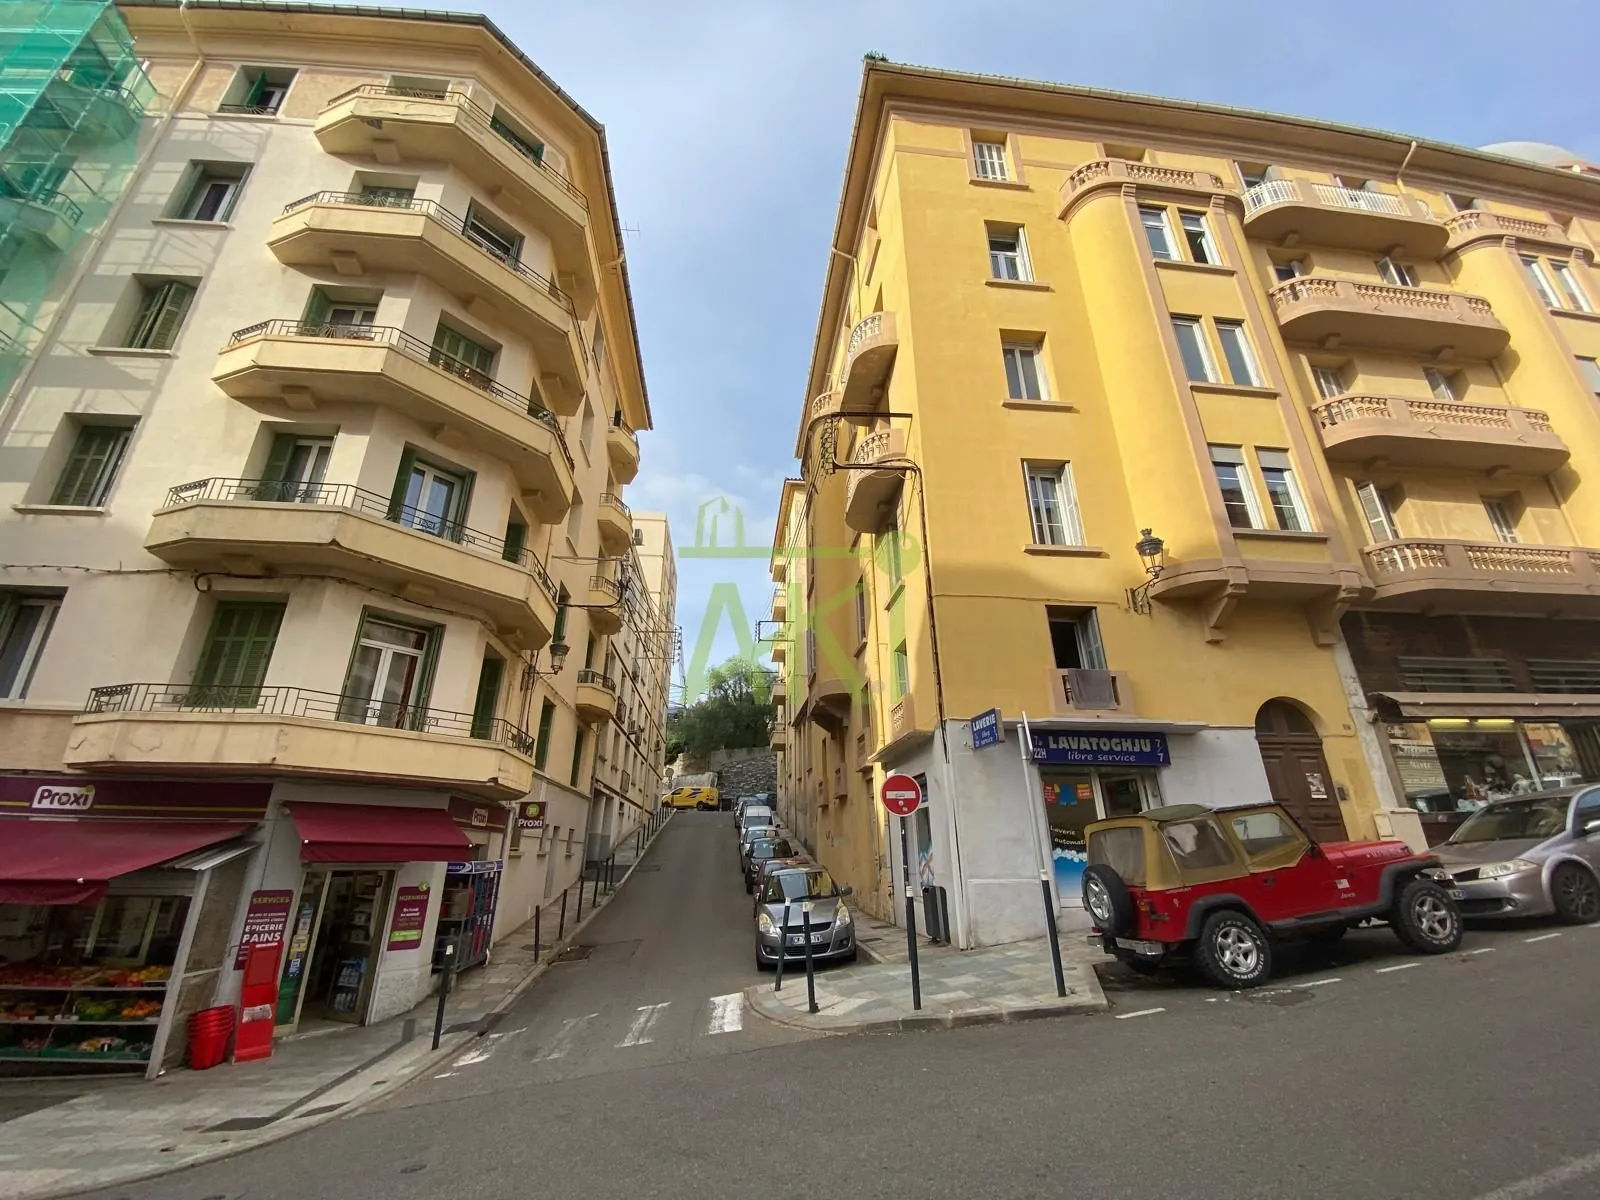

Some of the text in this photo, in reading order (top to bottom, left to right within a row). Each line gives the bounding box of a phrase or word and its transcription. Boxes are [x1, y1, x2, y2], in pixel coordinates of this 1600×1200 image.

[972, 713, 996, 731] LAVERIE
[1048, 735, 1152, 753] LAVATOGHJU
[1068, 751, 1094, 761] libre
[1097, 753, 1137, 762] service
[37, 785, 95, 806] Proxi
[518, 815, 544, 827] Proxi
[245, 923, 284, 933] EPICERIE
[242, 932, 281, 943] PAINS
